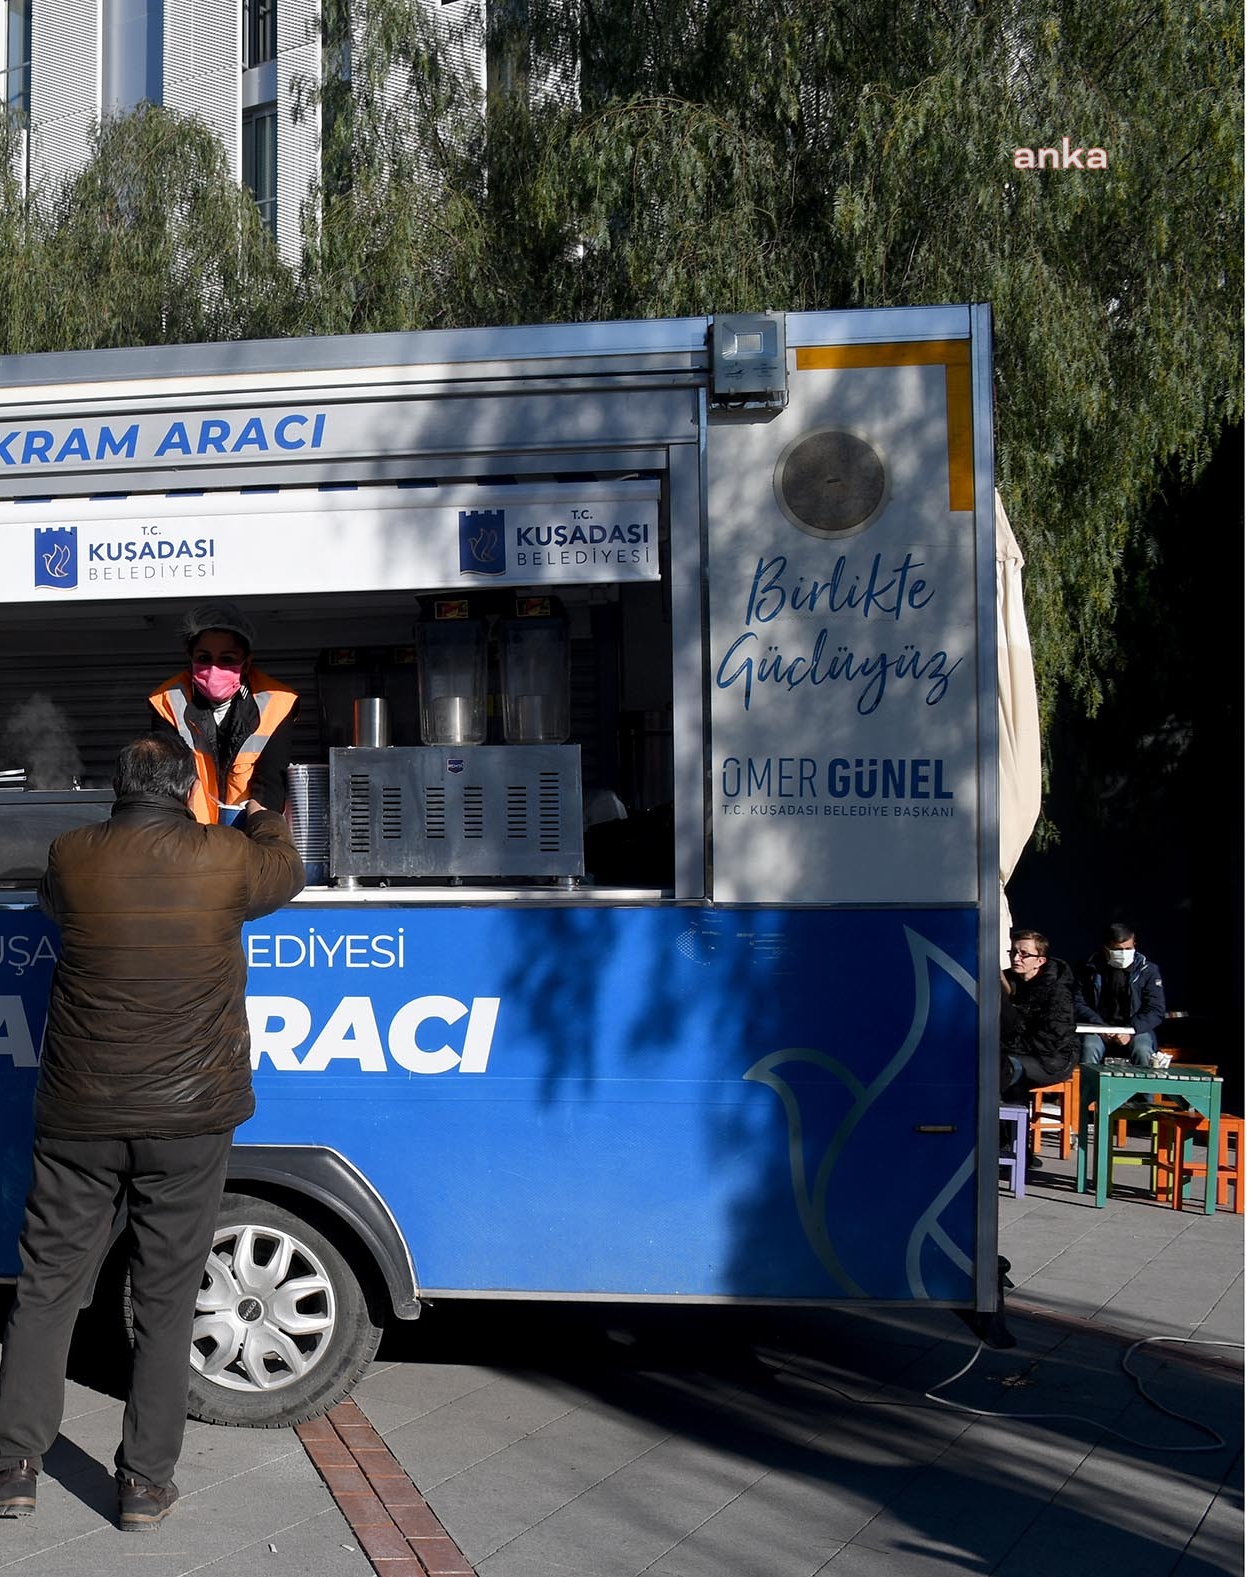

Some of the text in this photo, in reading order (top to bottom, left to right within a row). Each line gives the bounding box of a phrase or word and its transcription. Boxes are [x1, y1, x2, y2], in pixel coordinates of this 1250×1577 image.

[153, 413, 327, 458] ARACI
[571, 509, 593, 520] T.C.
[141, 526, 162, 536] T.C.
[516, 523, 649, 547] KUŞADASI
[89, 539, 214, 562] KUŞADASI
[517, 547, 649, 566] BELEDİYESİ
[89, 561, 215, 581] BELEDİYESİ
[745, 553, 935, 626] Birlikte
[716, 628, 963, 715] Güçlüyüz
[828, 758, 954, 800] GÜNEL
[722, 803, 954, 818] T.C. KUŞADASI BELEDİYE BAŞKANI
[247, 927, 405, 968] EDİYESİ
[245, 995, 501, 1074] RACI
